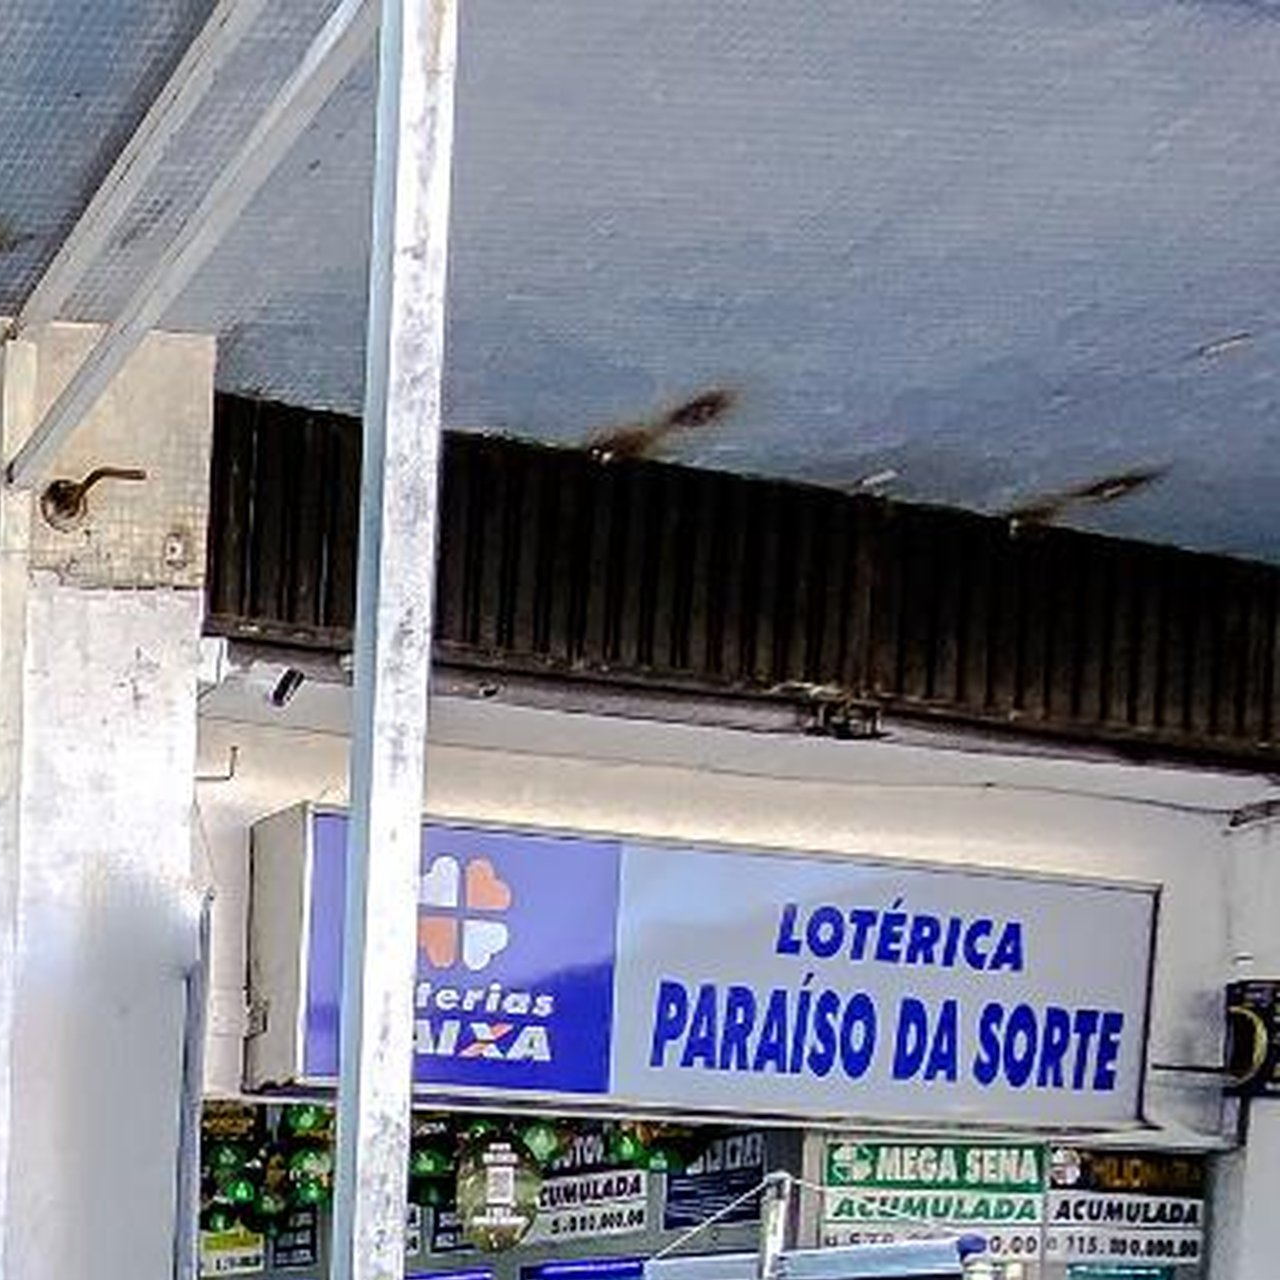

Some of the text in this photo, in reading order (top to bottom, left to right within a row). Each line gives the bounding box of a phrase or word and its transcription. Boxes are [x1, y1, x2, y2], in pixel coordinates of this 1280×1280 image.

[775, 898, 1024, 972] LOTÉRICA
[414, 982, 554, 1018] terias
[413, 1019, 552, 1062] AIXA
[650, 973, 1124, 1091] PARAÍSO DA SORTE
[876, 1145, 1039, 1185] MEGA SENA
[1053, 1202, 1199, 1224] ACUMULADA
